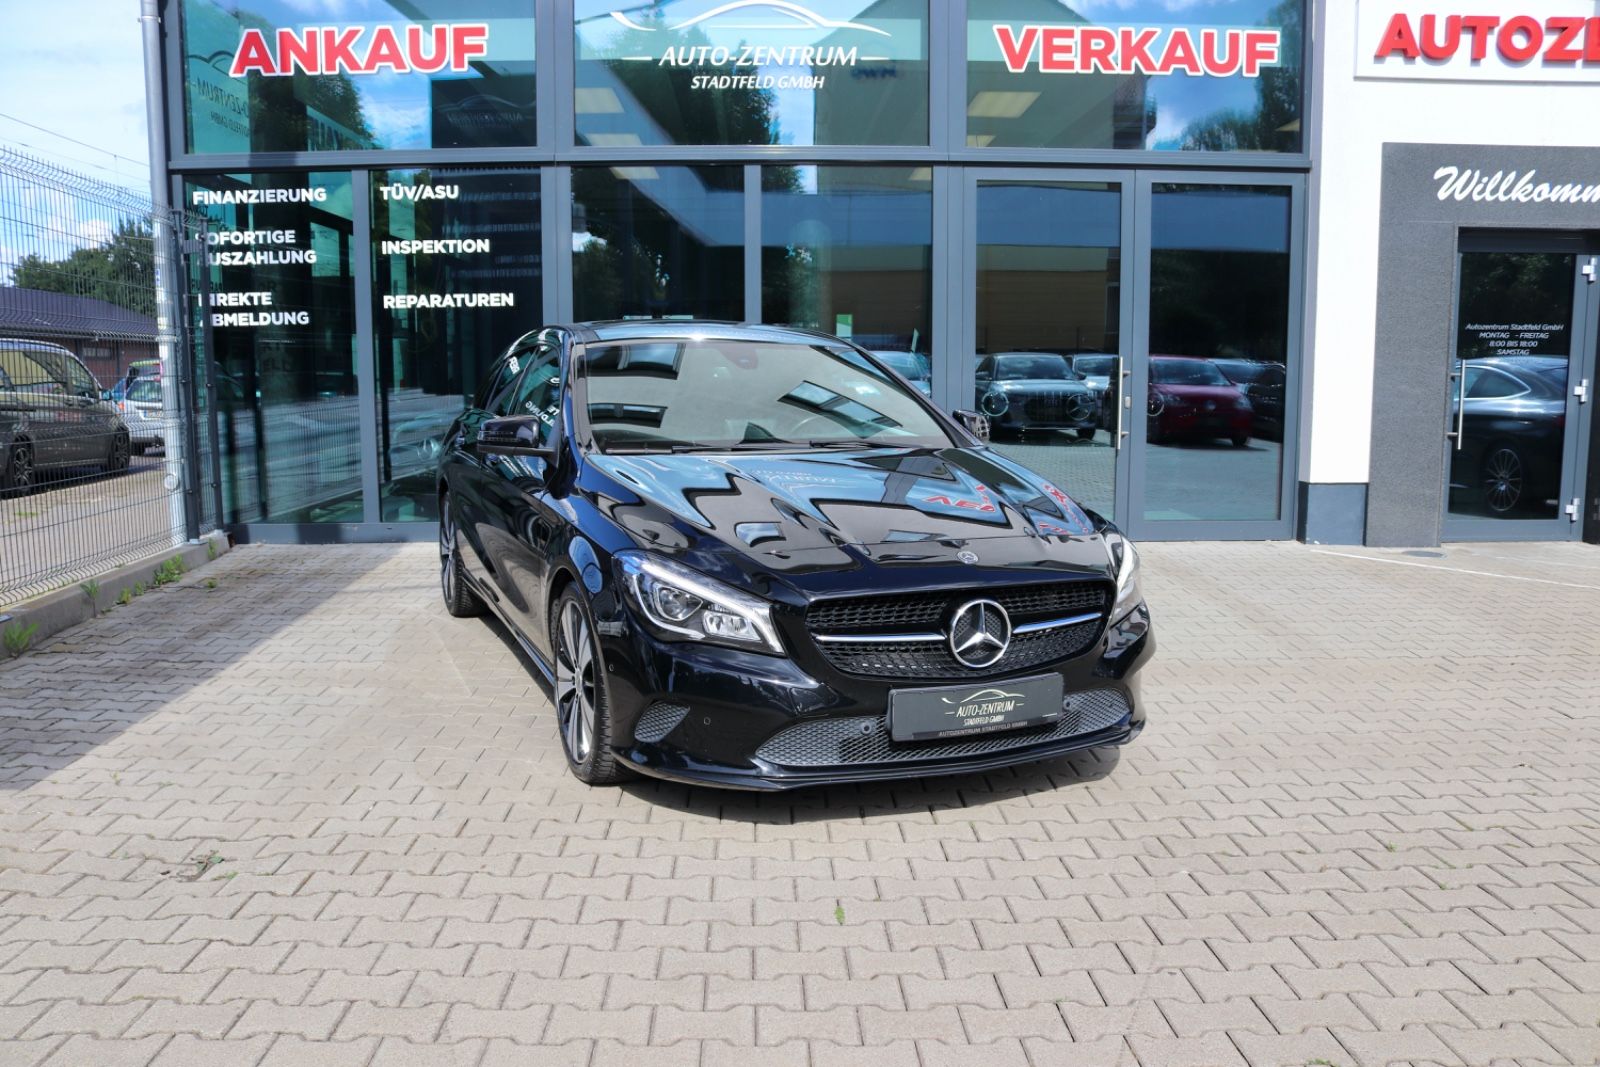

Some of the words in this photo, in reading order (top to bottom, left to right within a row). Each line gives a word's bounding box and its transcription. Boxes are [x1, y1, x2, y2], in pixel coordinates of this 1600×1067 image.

[229, 23, 489, 78] ANKAUF
[658, 46, 858, 67] AUTO-ZENTRUM
[993, 24, 1282, 77] VERKAUF
[691, 76, 774, 90] STADTFELD
[777, 75, 825, 89] GMBH
[192, 187, 327, 205] FINANZIERUNG
[379, 183, 459, 202] TÜV/ASU
[381, 239, 491, 255] INSPEKTION
[197, 249, 318, 266] USZAHLUNG
[198, 291, 273, 308] IREKTE
[383, 293, 515, 309] REPARATUREN
[199, 310, 310, 327] BMELDUNG
[957, 701, 1015, 717] AUTO-ZENTRUM
